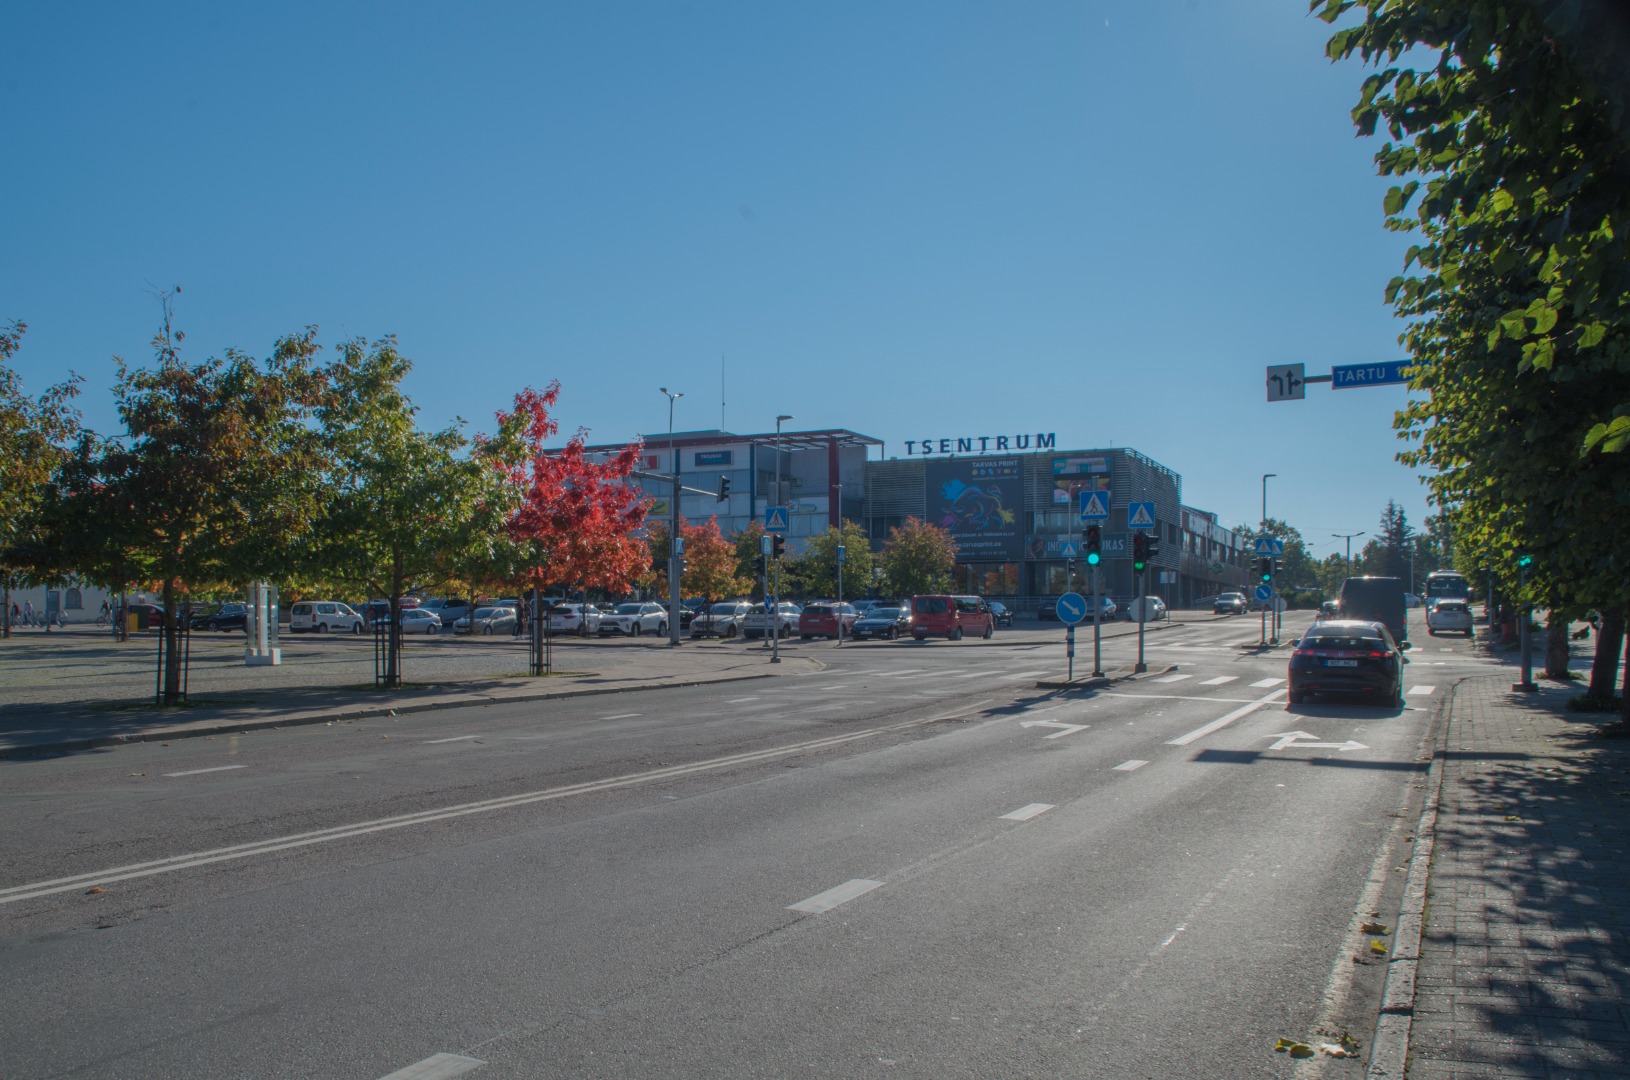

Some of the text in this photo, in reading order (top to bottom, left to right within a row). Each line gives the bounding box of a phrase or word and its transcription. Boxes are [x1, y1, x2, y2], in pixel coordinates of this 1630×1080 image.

[1337, 367, 1386, 383] TARTU
[904, 432, 1055, 456] TSENTRUM
[971, 460, 1018, 469] TARVAS PRINT
